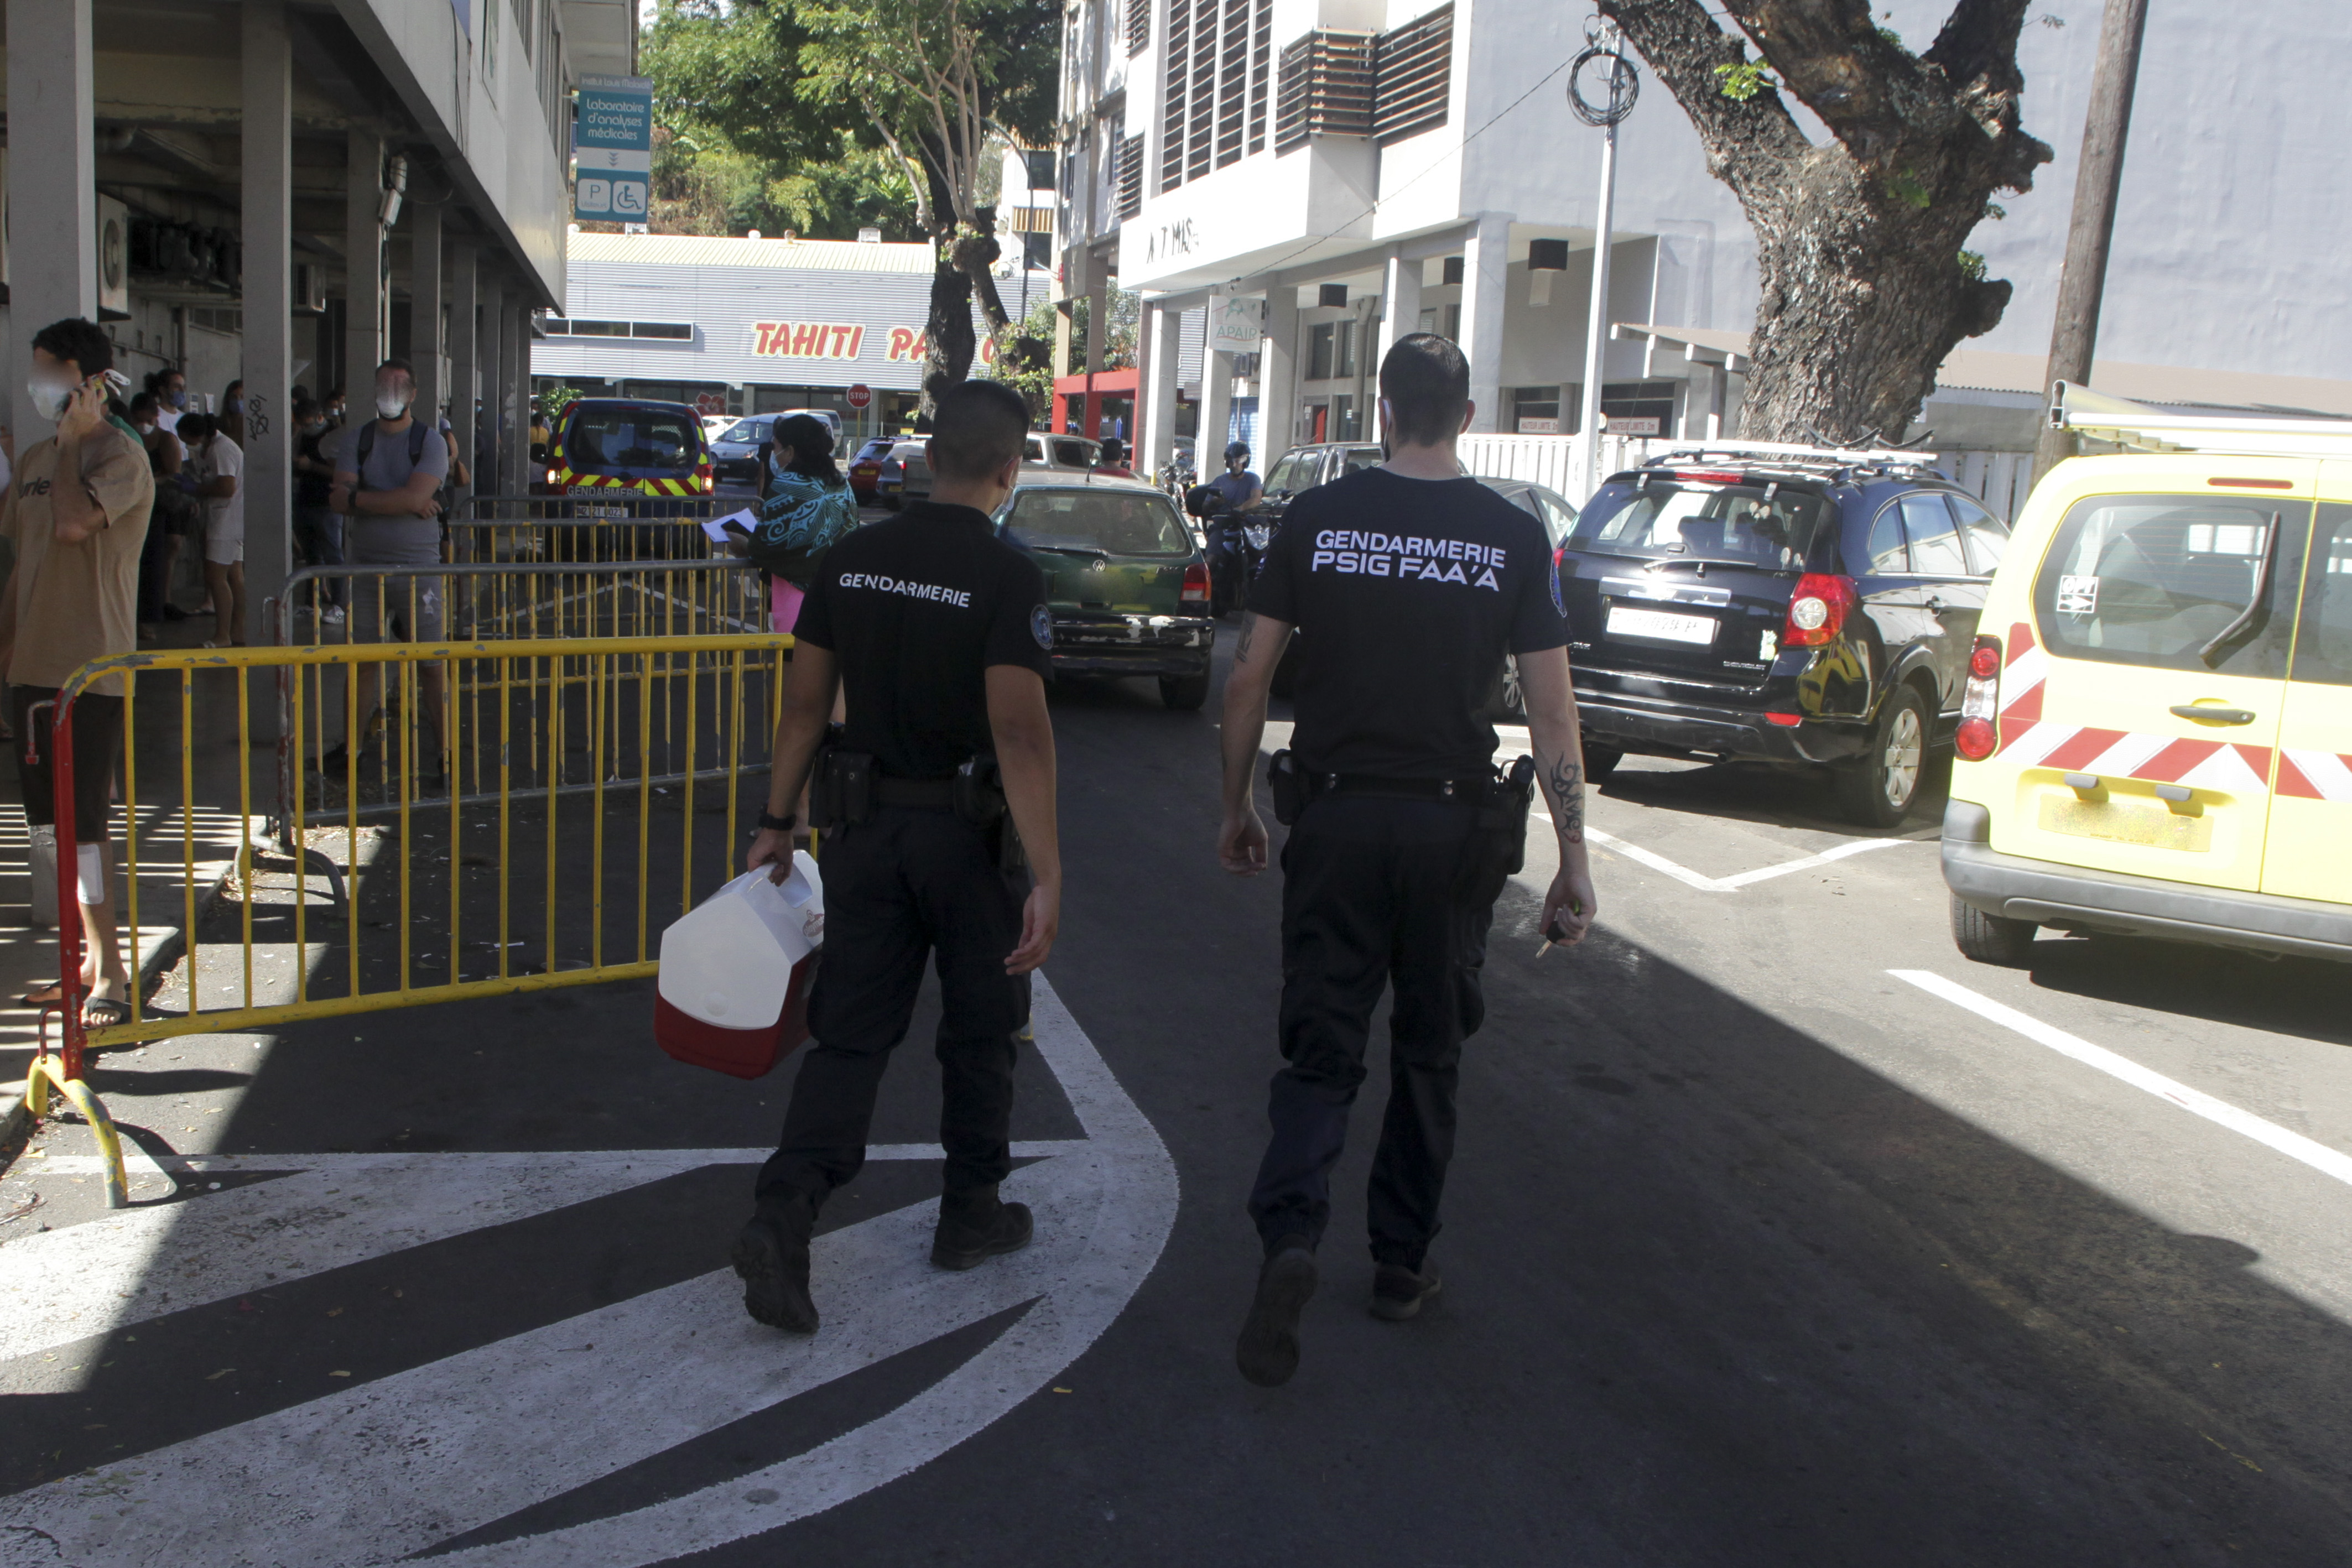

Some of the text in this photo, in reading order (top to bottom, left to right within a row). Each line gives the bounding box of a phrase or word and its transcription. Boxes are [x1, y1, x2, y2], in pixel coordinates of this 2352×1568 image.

[587, 98, 644, 113] Laboratoire
[588, 112, 642, 128] d'analyses
[588, 127, 637, 140] médicales
[590, 184, 600, 199] P
[1216, 325, 1257, 340] APAIR
[753, 321, 930, 362] TAHITI PA
[850, 392, 869, 400] STOP
[1609, 422, 1629, 431] HAUTEUR
[566, 485, 644, 497] GENDARMERIE
[1316, 530, 1506, 569] GENDARMERIE
[1312, 551, 1500, 592] PSIG FAA'A
[839, 572, 971, 608] GENDARMERIE
[2062, 577, 2096, 593] OPT
[804, 915, 824, 935] playma
